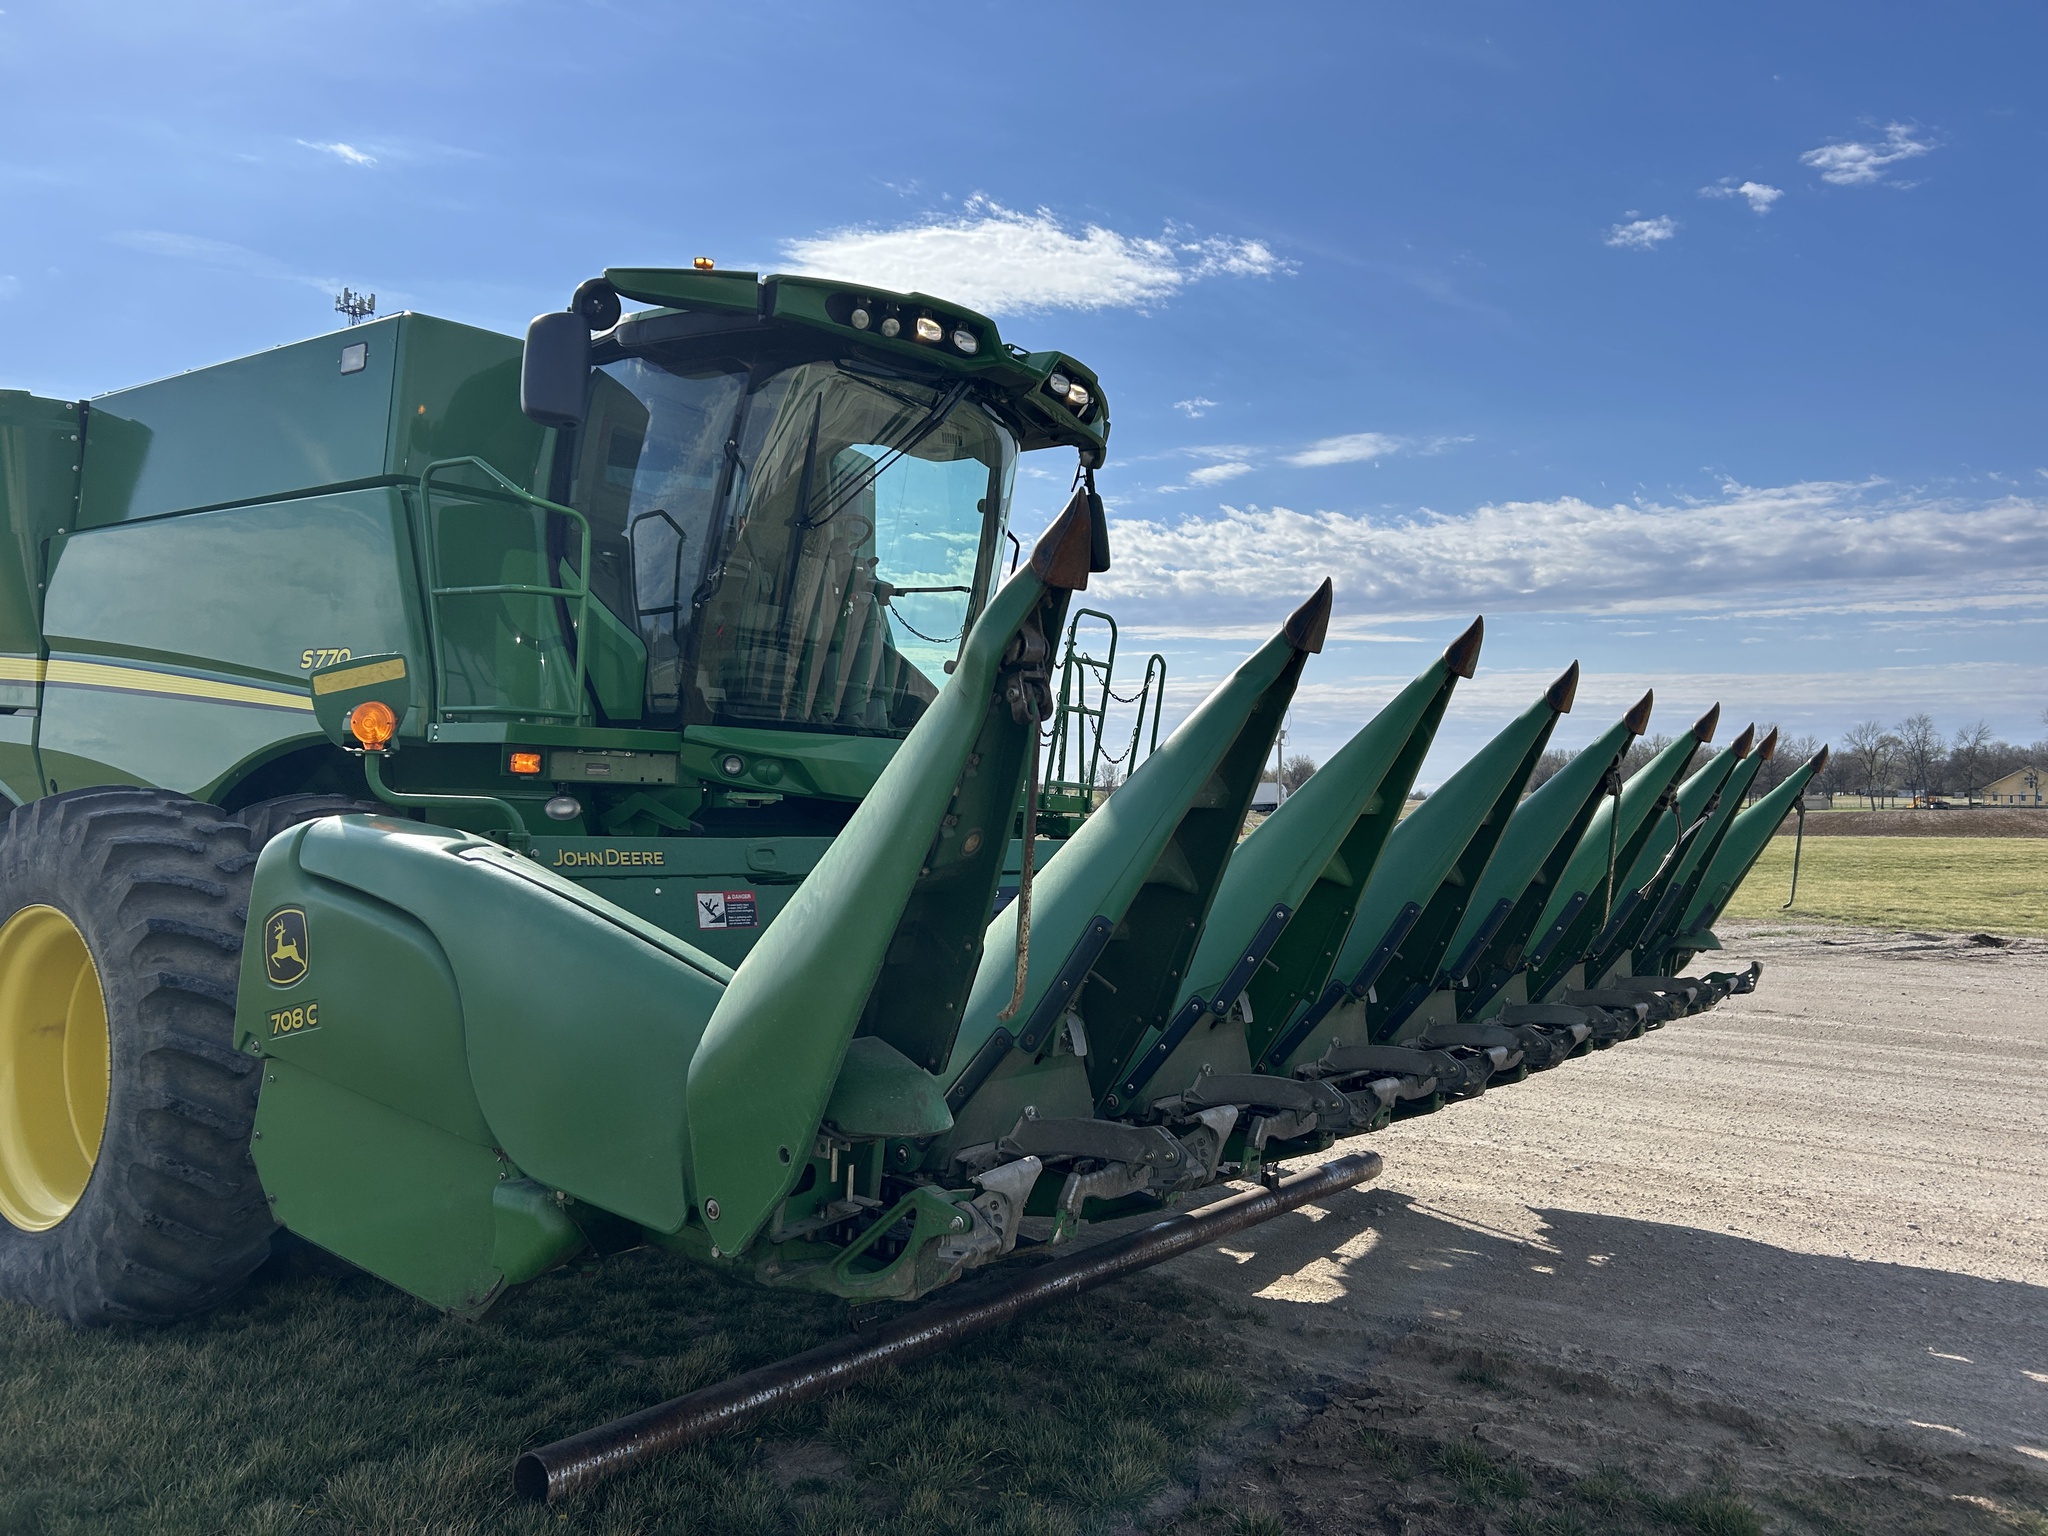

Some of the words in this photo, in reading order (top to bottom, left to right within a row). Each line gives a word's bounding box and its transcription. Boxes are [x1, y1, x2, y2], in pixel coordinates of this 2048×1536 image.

[300, 647, 351, 669] S770
[553, 849, 603, 866] JOHN
[605, 849, 665, 866] DEERE
[270, 1003, 318, 1034] 708C
